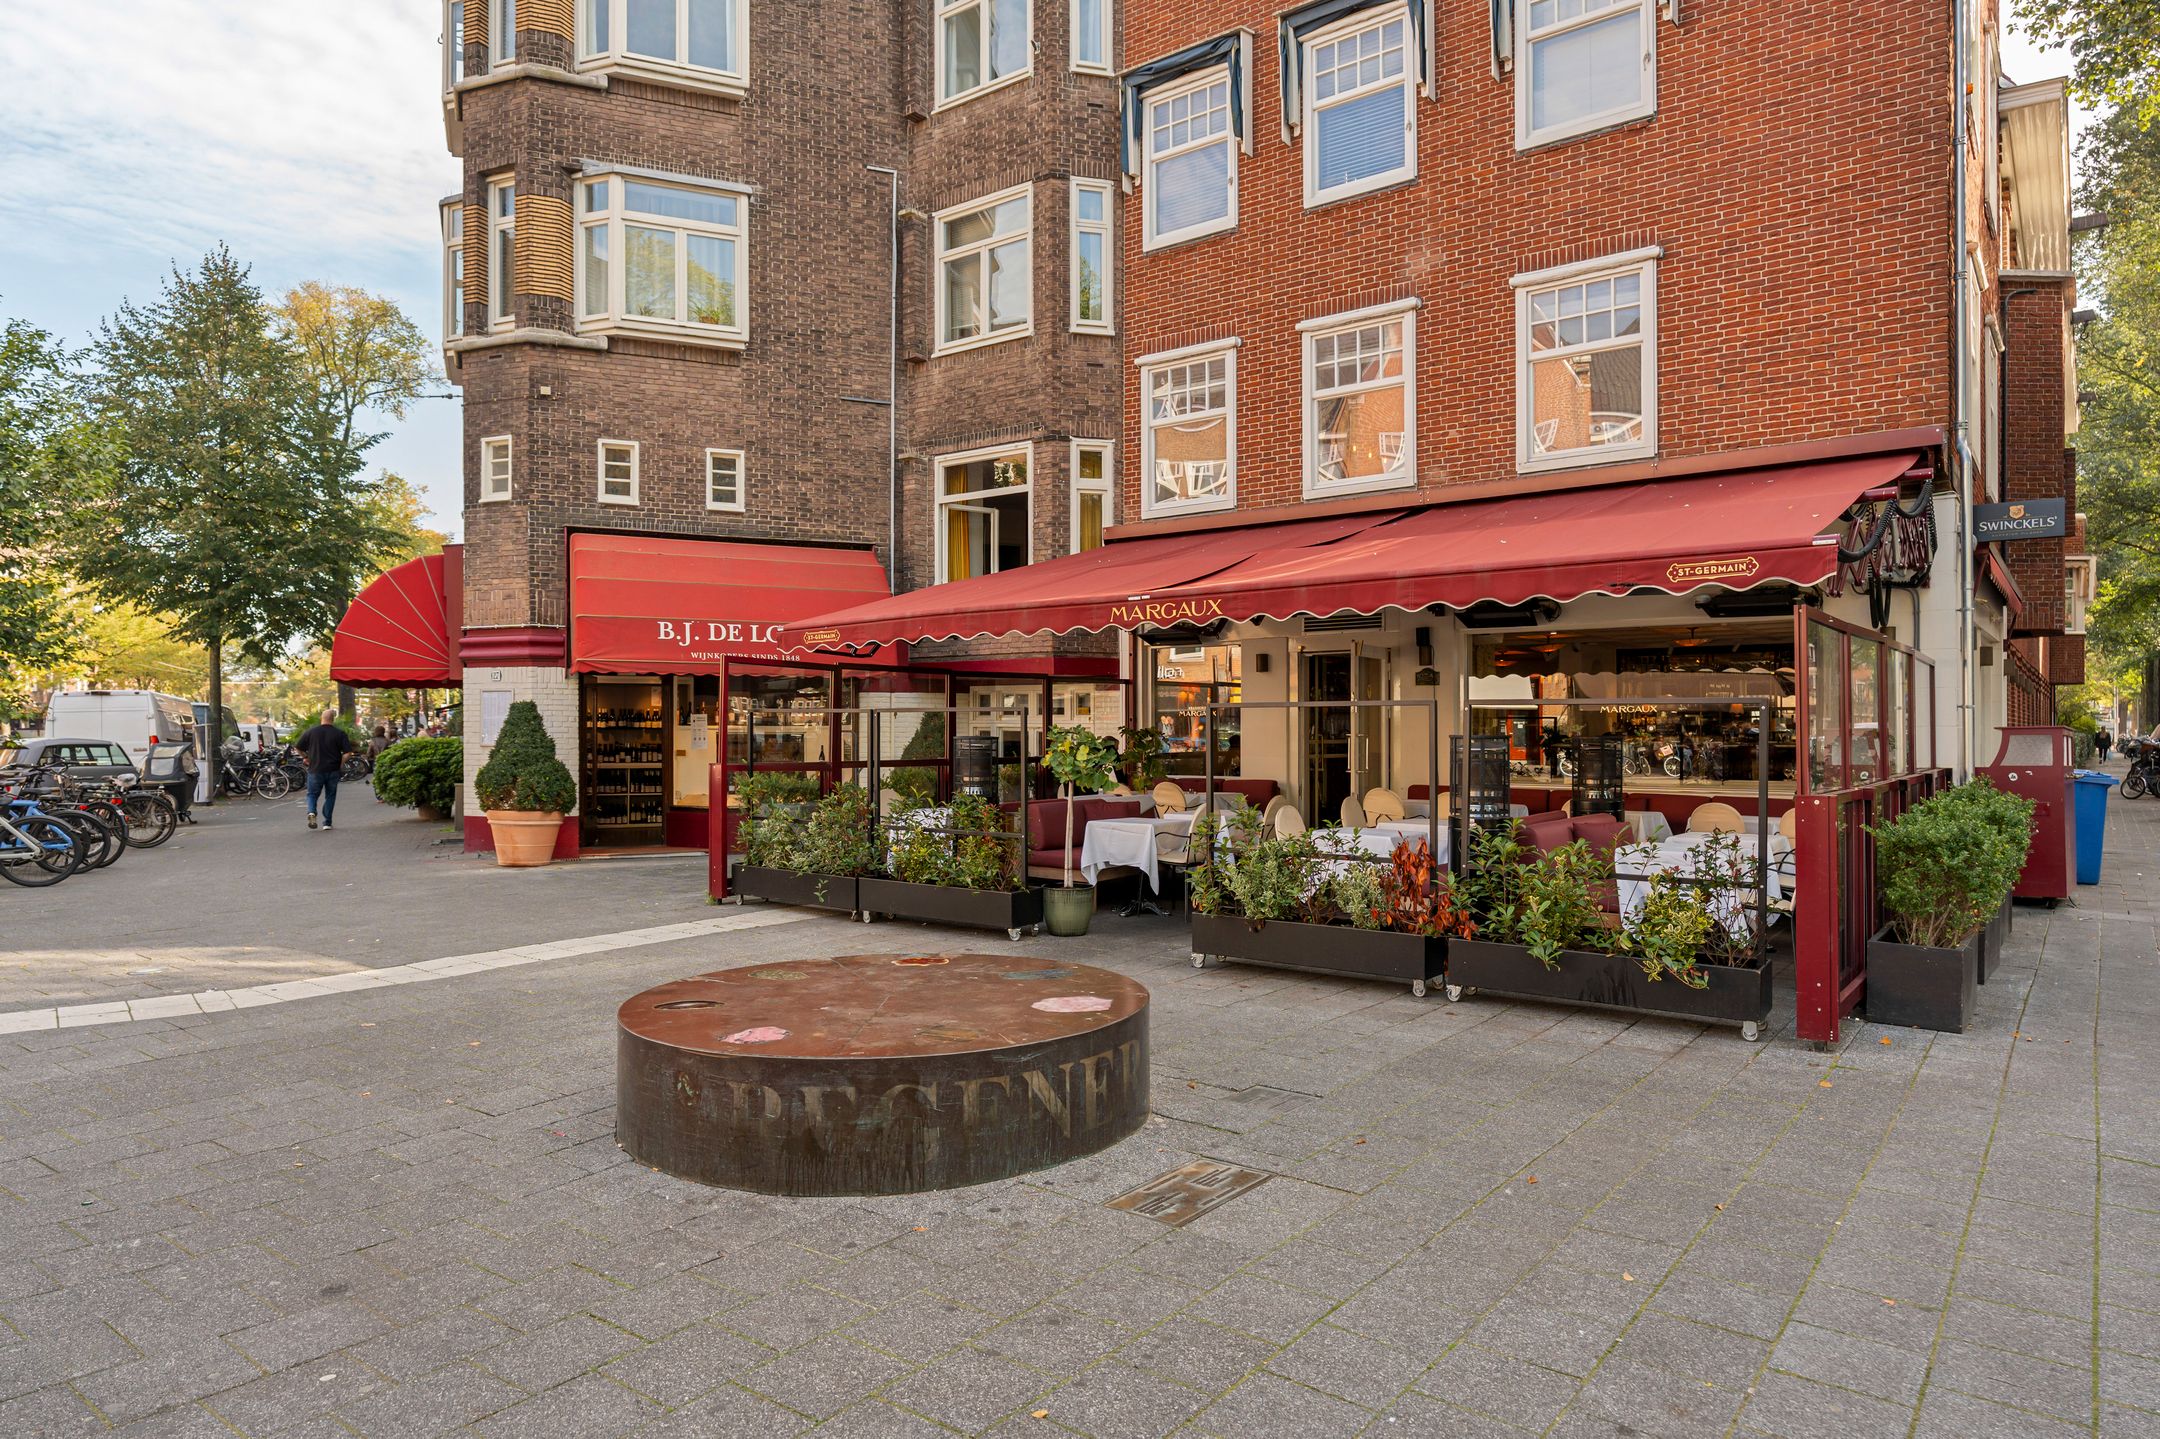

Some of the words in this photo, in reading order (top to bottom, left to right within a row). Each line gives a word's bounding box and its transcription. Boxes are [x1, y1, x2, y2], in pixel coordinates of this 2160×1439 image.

[1979, 516, 2057, 532] SWINCKELS'
[1677, 563, 1747, 576] ST-GERMAIN
[1109, 599, 1224, 622] MARGAUX
[657, 621, 700, 647] B.J.
[708, 623, 743, 642] DE
[1599, 705, 1658, 713] MARGAUX
